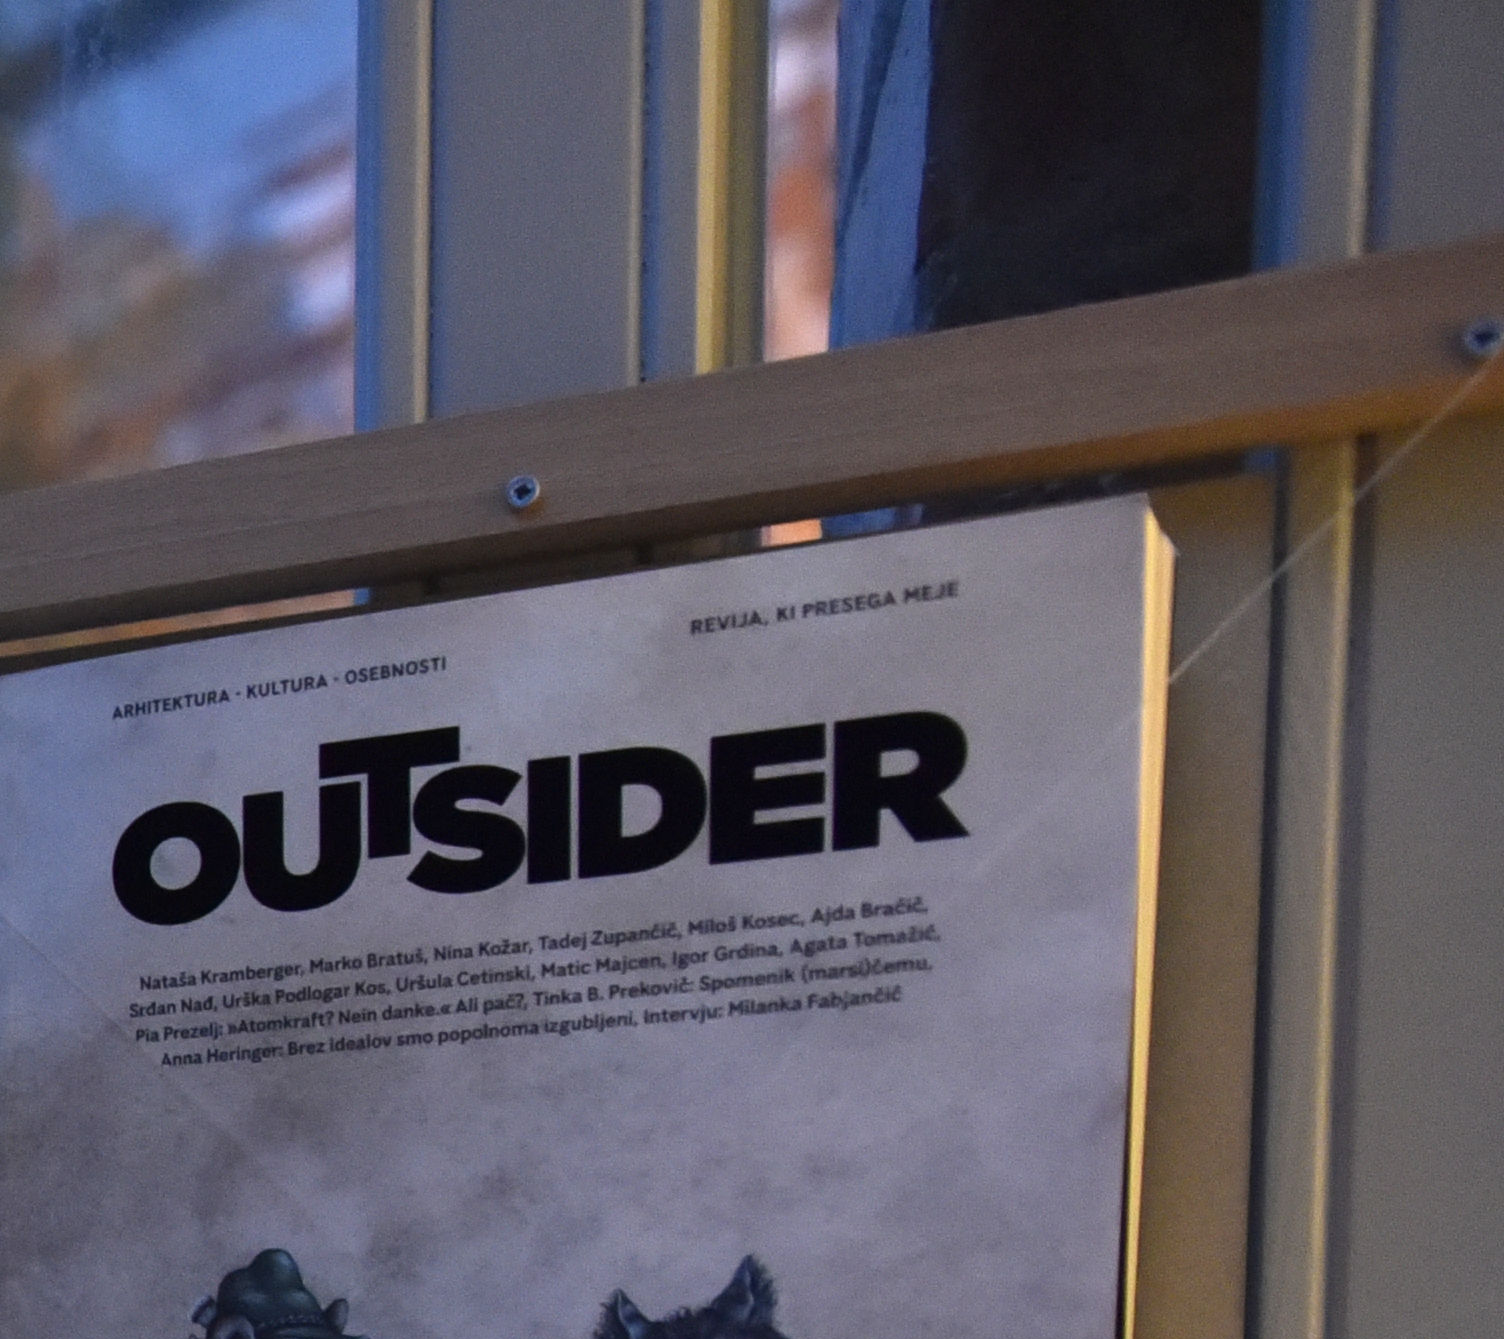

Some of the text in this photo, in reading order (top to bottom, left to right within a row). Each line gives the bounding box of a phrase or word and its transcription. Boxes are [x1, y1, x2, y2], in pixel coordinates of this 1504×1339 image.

[690, 579, 960, 635] REVIJA, KI PRESEGA MEJE
[112, 656, 447, 720] ARHITEKTURA KULTURA OSEBNOSTI
[111, 710, 971, 926] OUTSIDER
[139, 971, 198, 991] Nataša
[199, 964, 305, 985] Kramberger,
[308, 955, 364, 974] Marko
[366, 947, 429, 970] Bratuš,
[433, 945, 475, 962] Nina
[477, 938, 533, 957] Kožar,
[537, 932, 588, 951] Tadej
[687, 915, 738, 935] Miloš
[741, 913, 806, 930] Kosec,
[810, 904, 856, 927] Ajda
[221, 990, 272, 1010] Urška
[274, 985, 351, 1005] Podlogar
[354, 981, 392, 997] Kos,
[395, 973, 454, 993] Uršula
[456, 965, 536, 987] Cetinski,
[540, 960, 591, 978] Matic
[595, 955, 667, 975] Majcen,
[671, 950, 710, 970] Igor
[713, 943, 784, 963] Grdina,
[789, 935, 848, 958] Agata
[135, 1028, 160, 1043] Pia
[163, 1021, 224, 1041] Prezelj:
[337, 1008, 378, 1025] Nein
[454, 997, 479, 1014] Ali
[532, 988, 583, 1007] Tinka
[586, 985, 605, 1003] B.
[698, 967, 795, 993] Spomenik
[161, 1052, 204, 1067] Anna
[205, 1045, 284, 1064] Heringer:
[287, 1040, 326, 1057] Brez
[329, 1033, 393, 1053] idealov
[396, 1031, 435, 1047] smo
[437, 1022, 541, 1046] popolnoma
[541, 1010, 639, 1037] izgubljeni,
[642, 1004, 723, 1025] Intervju:
[727, 996, 803, 1017] Milanka
